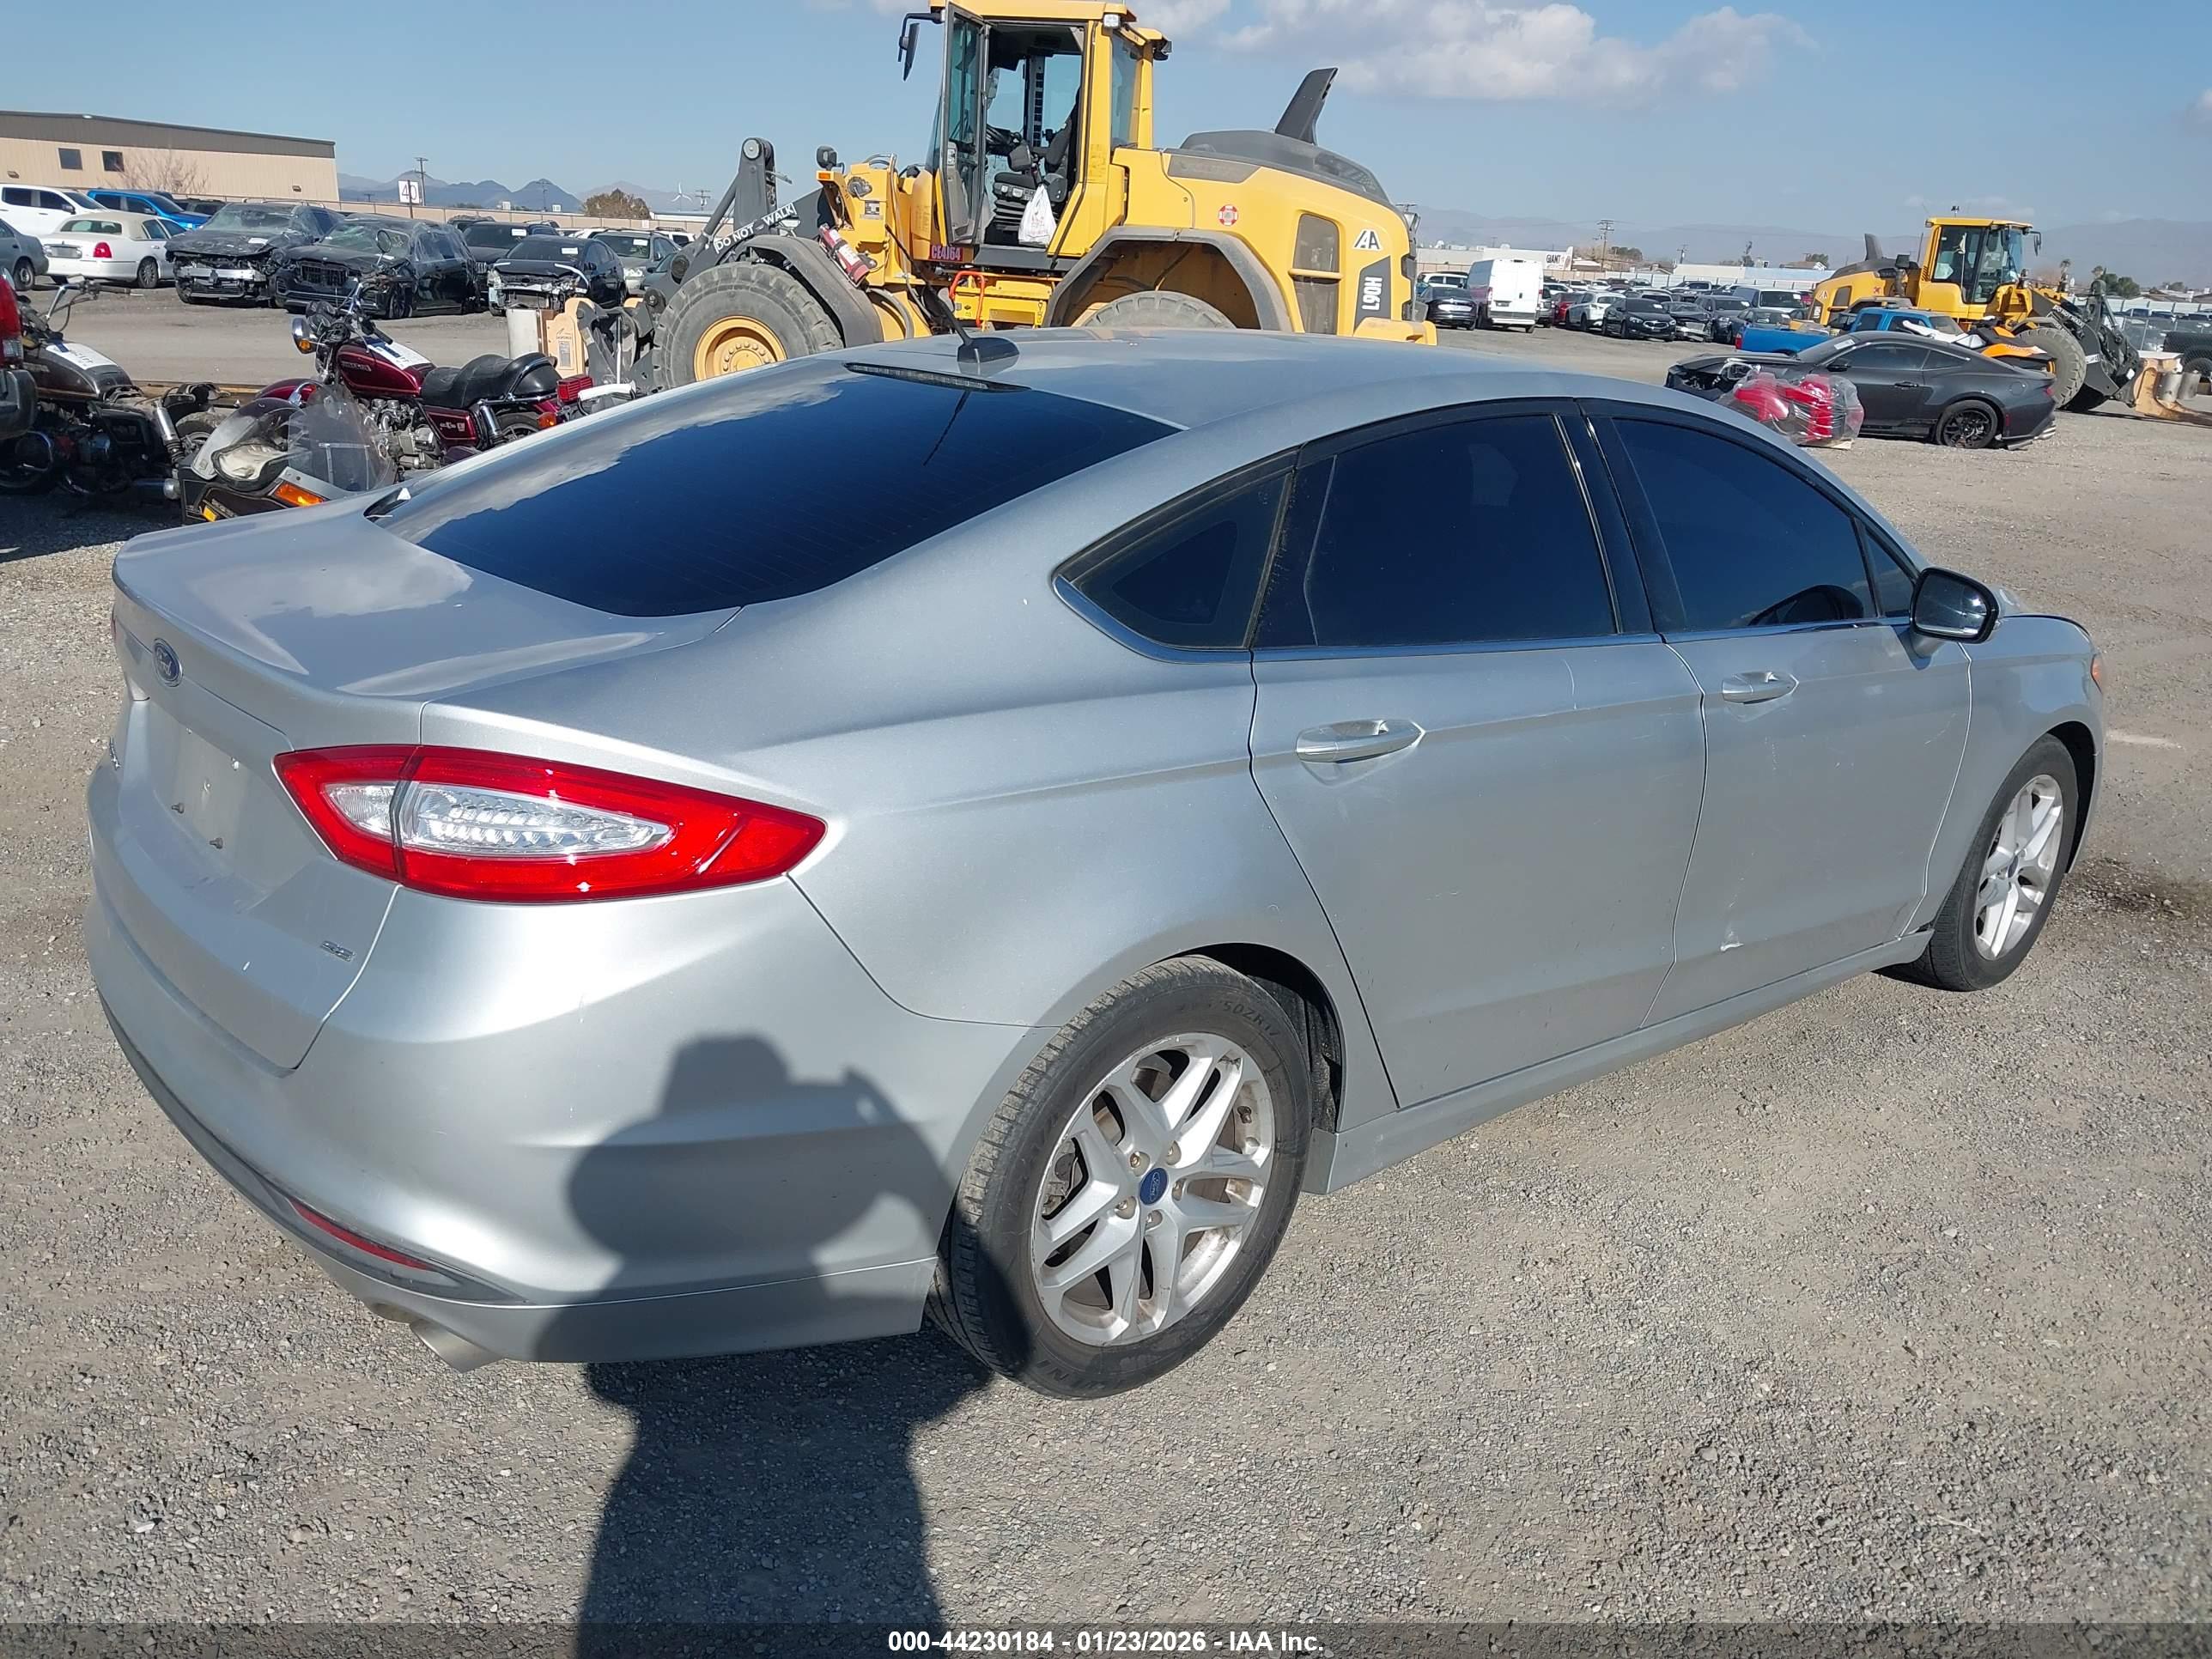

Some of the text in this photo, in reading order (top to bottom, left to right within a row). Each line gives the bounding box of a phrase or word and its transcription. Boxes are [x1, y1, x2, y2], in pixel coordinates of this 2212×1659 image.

[401, 184, 418, 200] 40
[717, 204, 794, 251] DO NOT WALK
[1361, 276, 1382, 311] L90H
